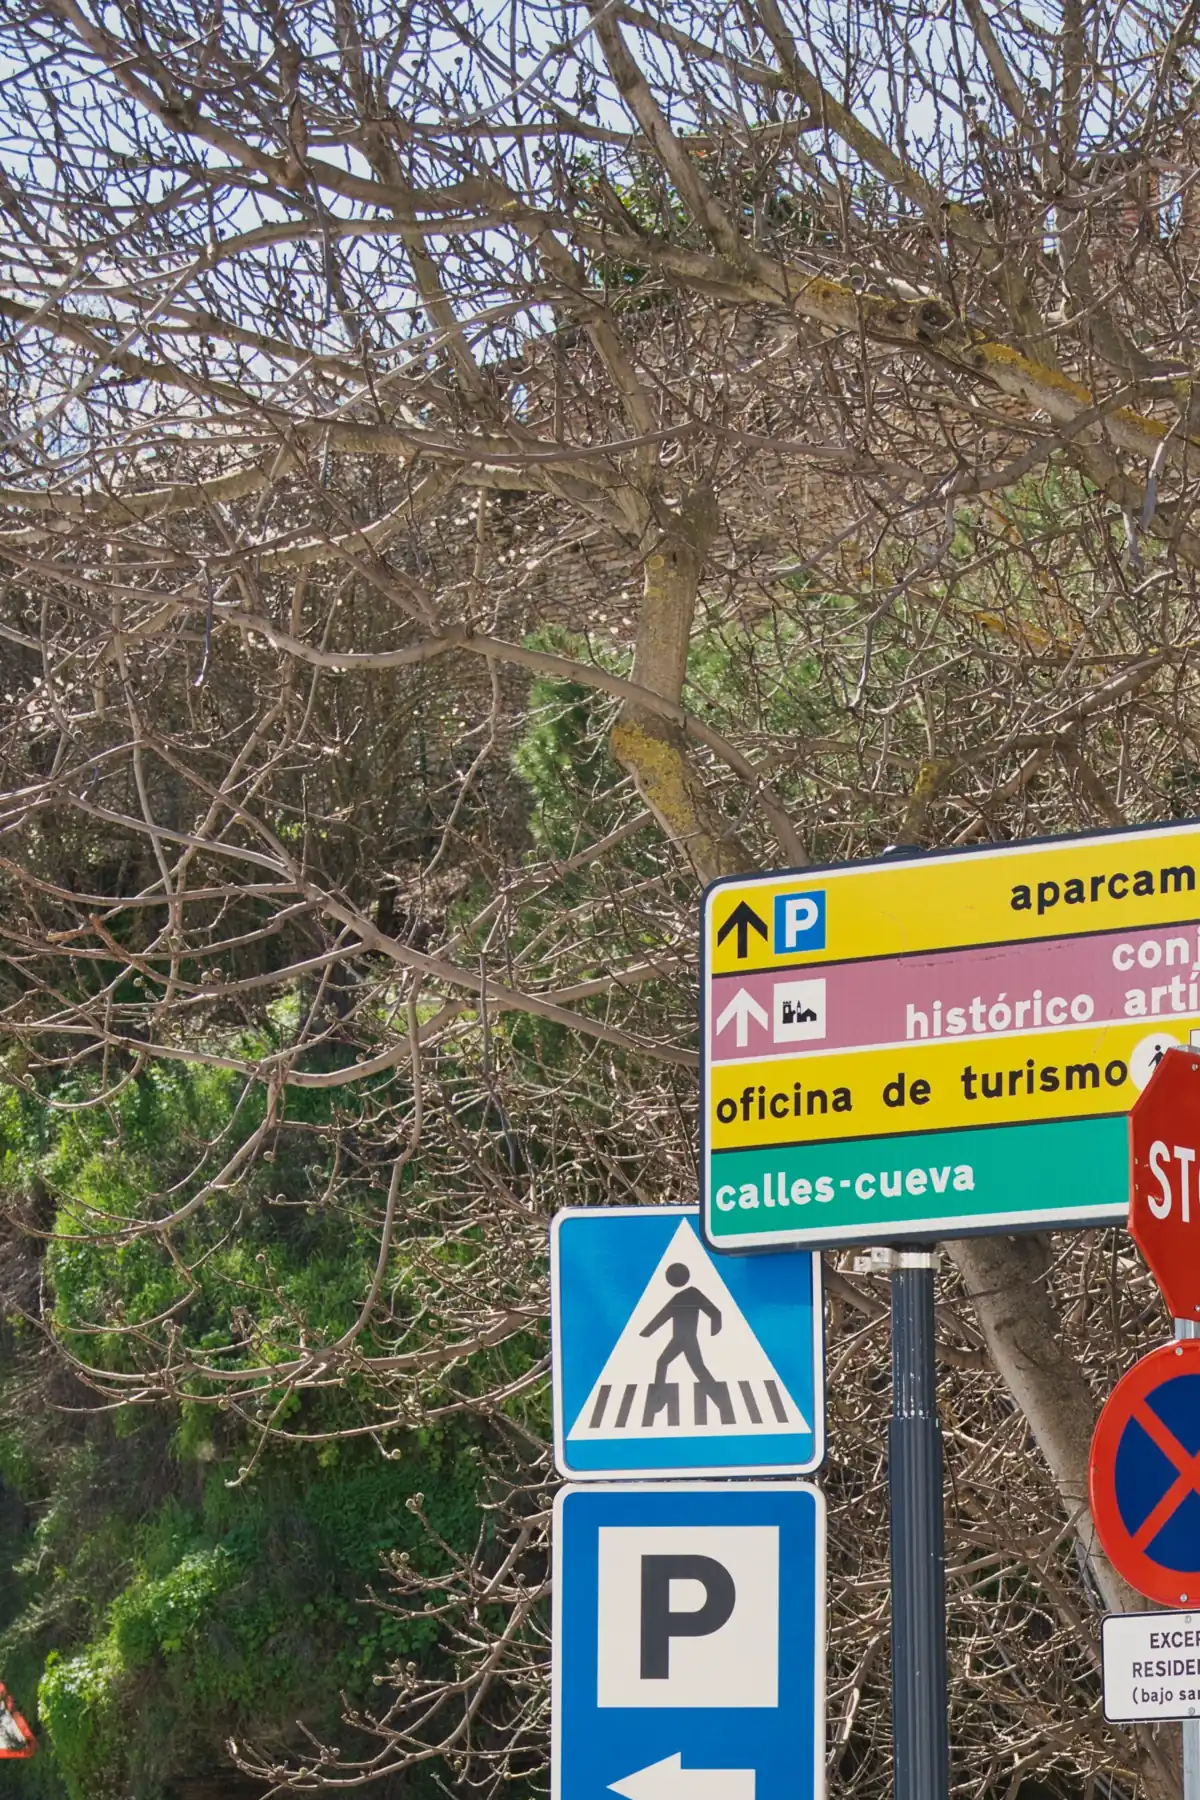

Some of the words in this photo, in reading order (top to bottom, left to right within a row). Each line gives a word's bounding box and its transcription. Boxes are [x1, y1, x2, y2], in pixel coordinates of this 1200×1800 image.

[785, 898, 819, 949] P
[906, 990, 1095, 1039] histórico
[716, 1083, 853, 1124] oficina
[882, 1072, 931, 1108] de
[960, 1057, 1128, 1099] turismo
[715, 1165, 975, 1212] calles-cueva
[640, 1554, 736, 1679] P
[1132, 1686, 1174, 1705] (bajo
